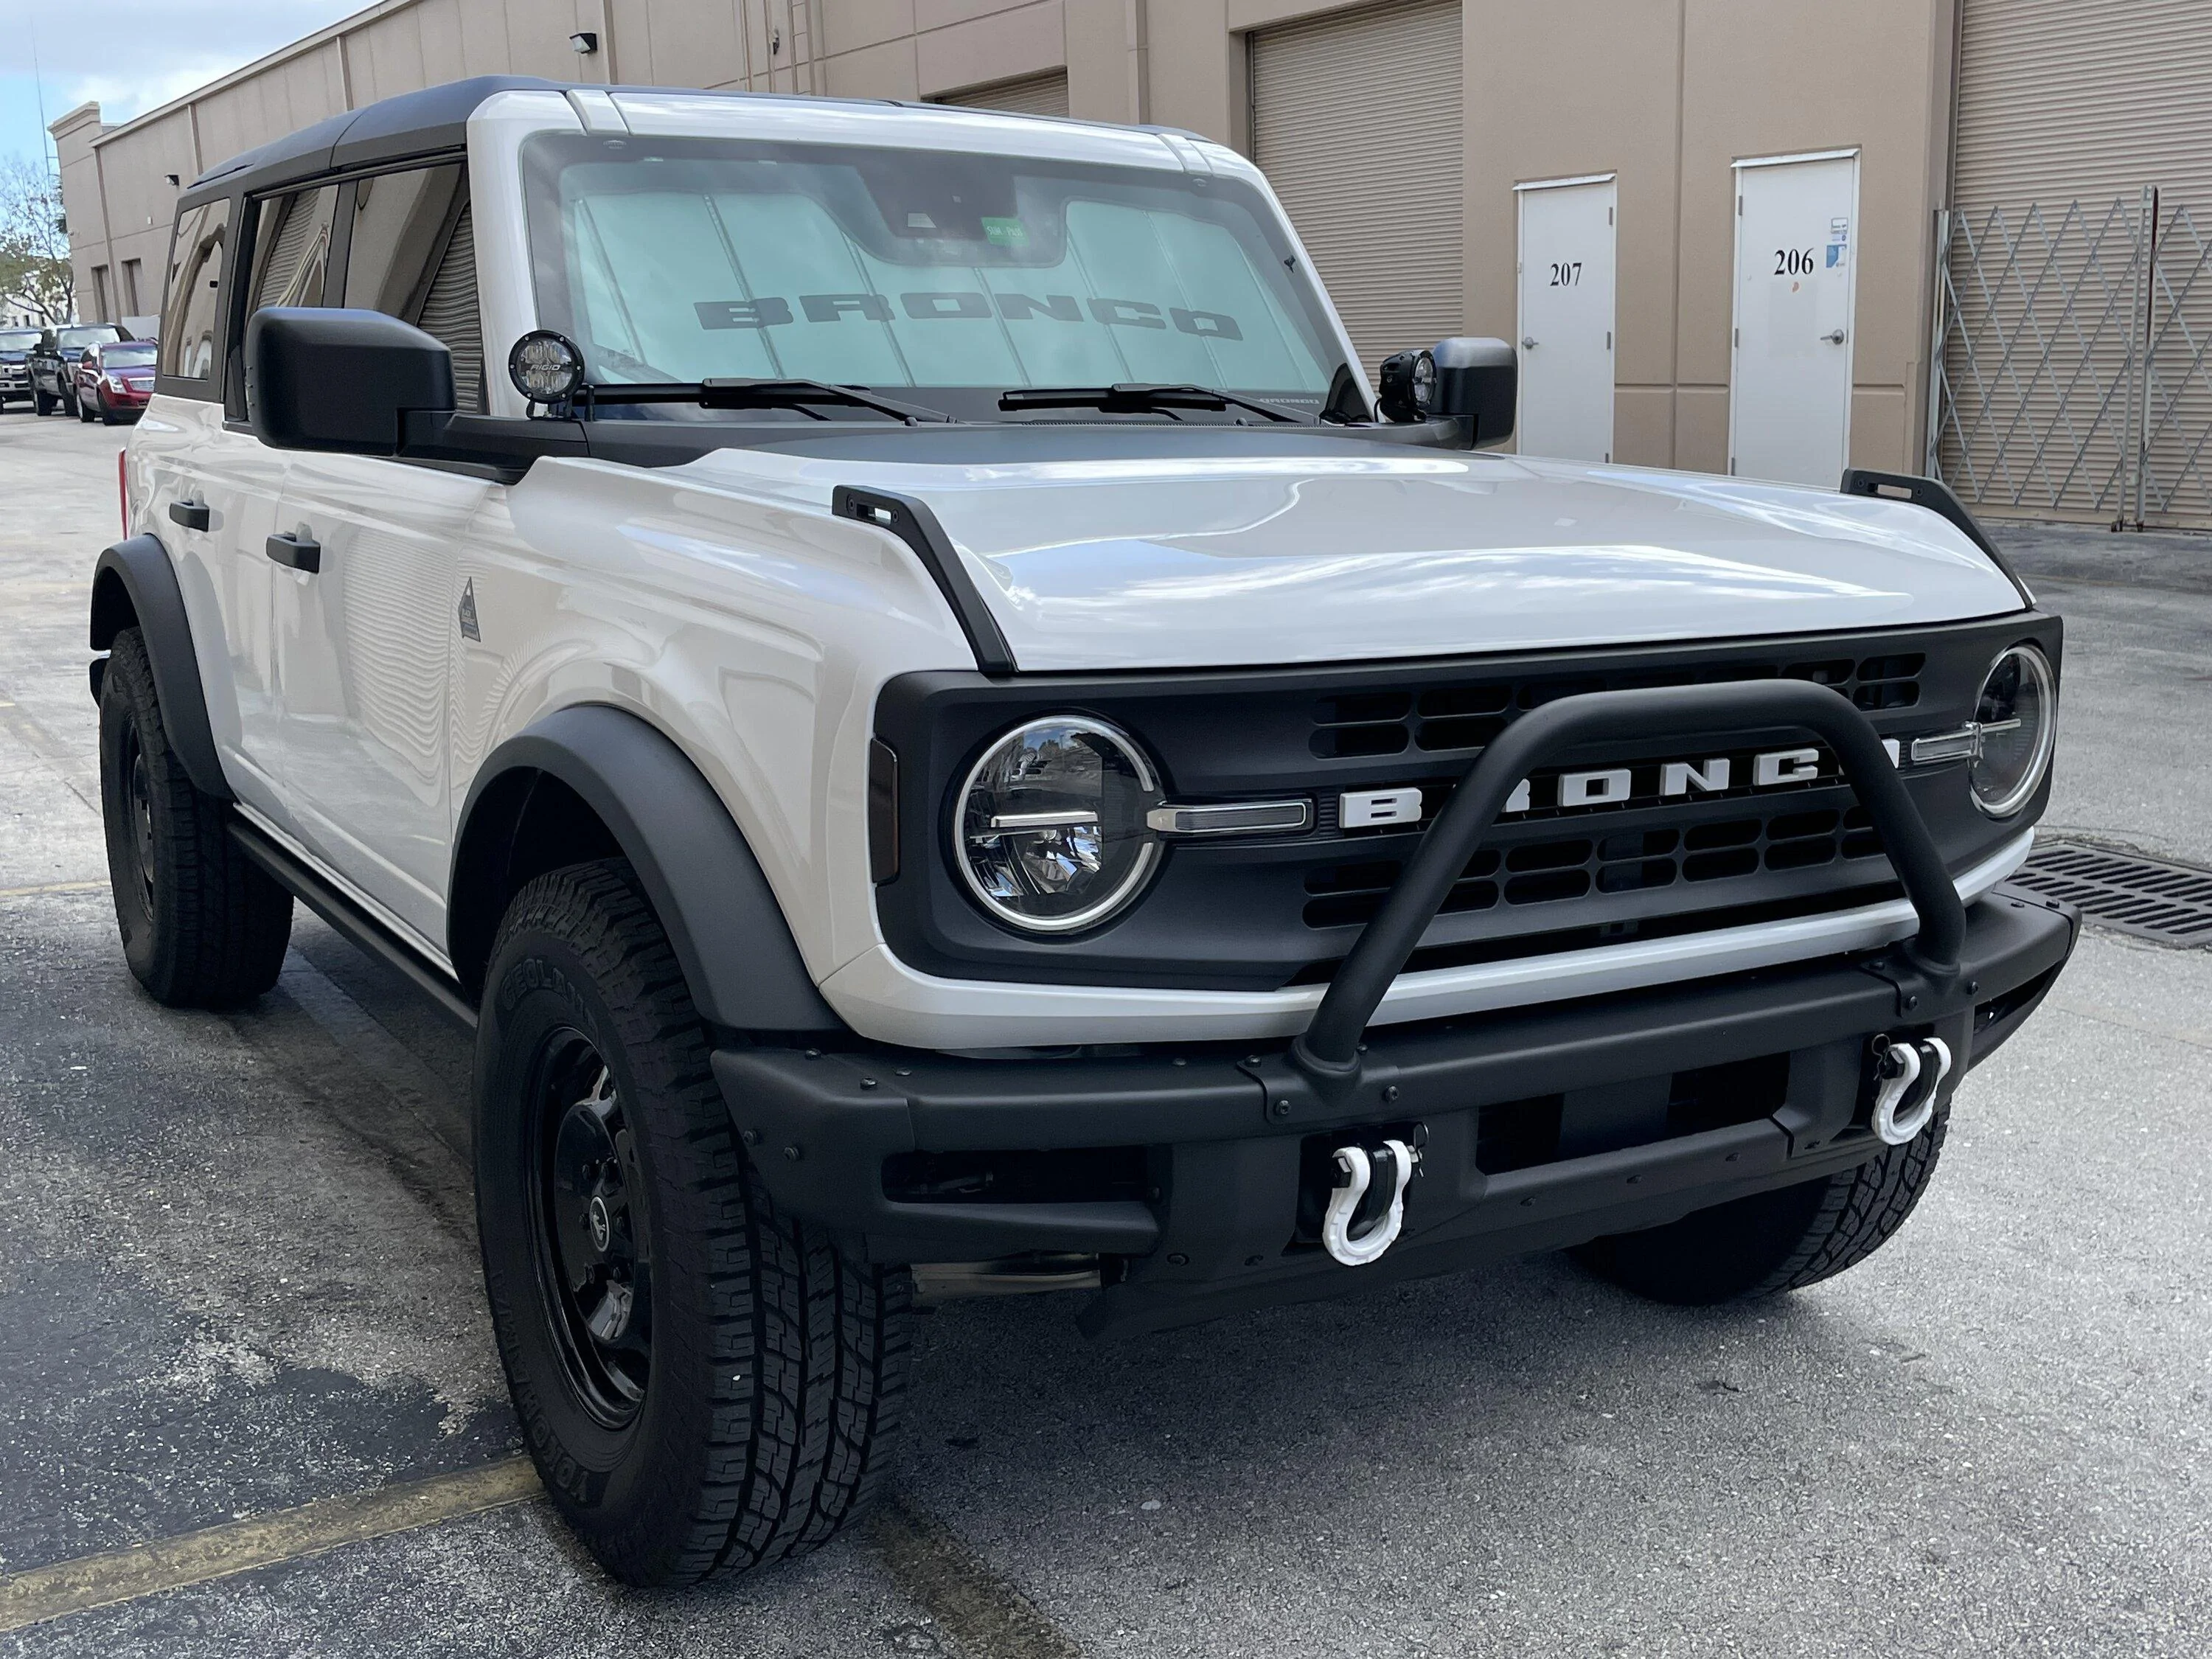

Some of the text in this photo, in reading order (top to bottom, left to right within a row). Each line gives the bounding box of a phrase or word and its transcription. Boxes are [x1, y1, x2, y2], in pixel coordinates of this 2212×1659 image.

[1550, 262, 1582, 286] 207
[1774, 248, 1814, 275] 206
[693, 292, 1244, 341] BRONCO
